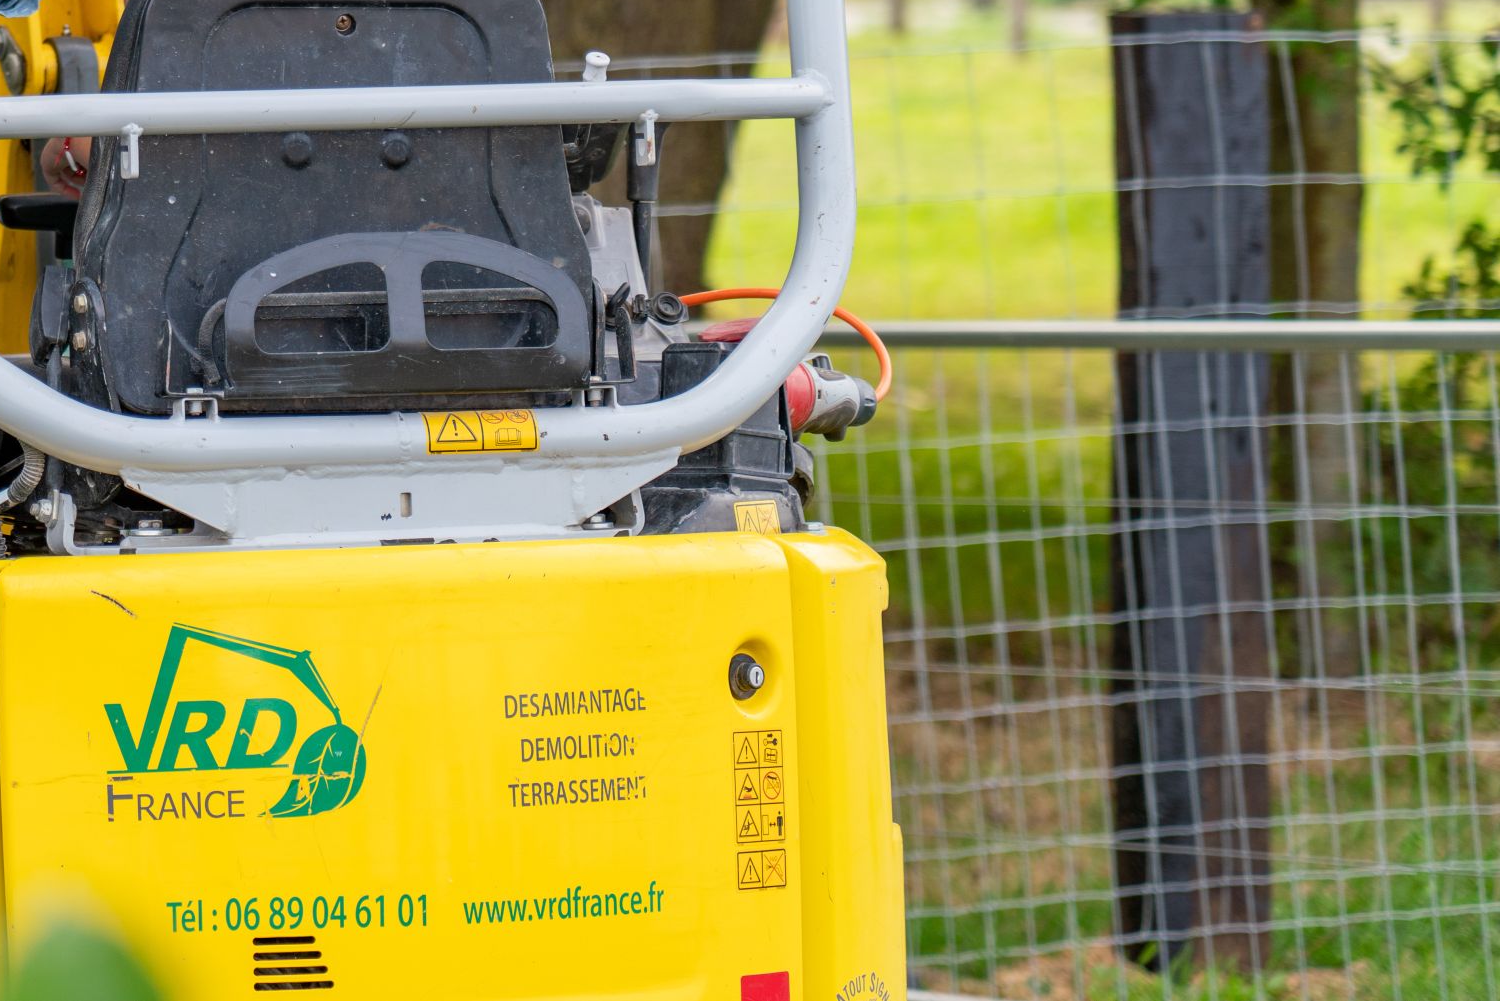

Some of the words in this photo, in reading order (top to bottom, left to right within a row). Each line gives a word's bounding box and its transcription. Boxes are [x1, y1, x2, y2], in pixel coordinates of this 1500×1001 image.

[504, 687, 647, 719] DESAMIANTAGE
[103, 692, 298, 773] VRD
[520, 732, 635, 763] DEMOLITION
[106, 775, 246, 823] FRANCE
[508, 775, 647, 808] TERRASSEMENT
[166, 899, 203, 933] Tél
[225, 897, 261, 932] 06
[268, 896, 304, 931] 89
[312, 895, 348, 930] 04
[355, 894, 385, 929] 61
[398, 893, 428, 929] 01
[463, 880, 665, 925] www.vrdfrance.fr
